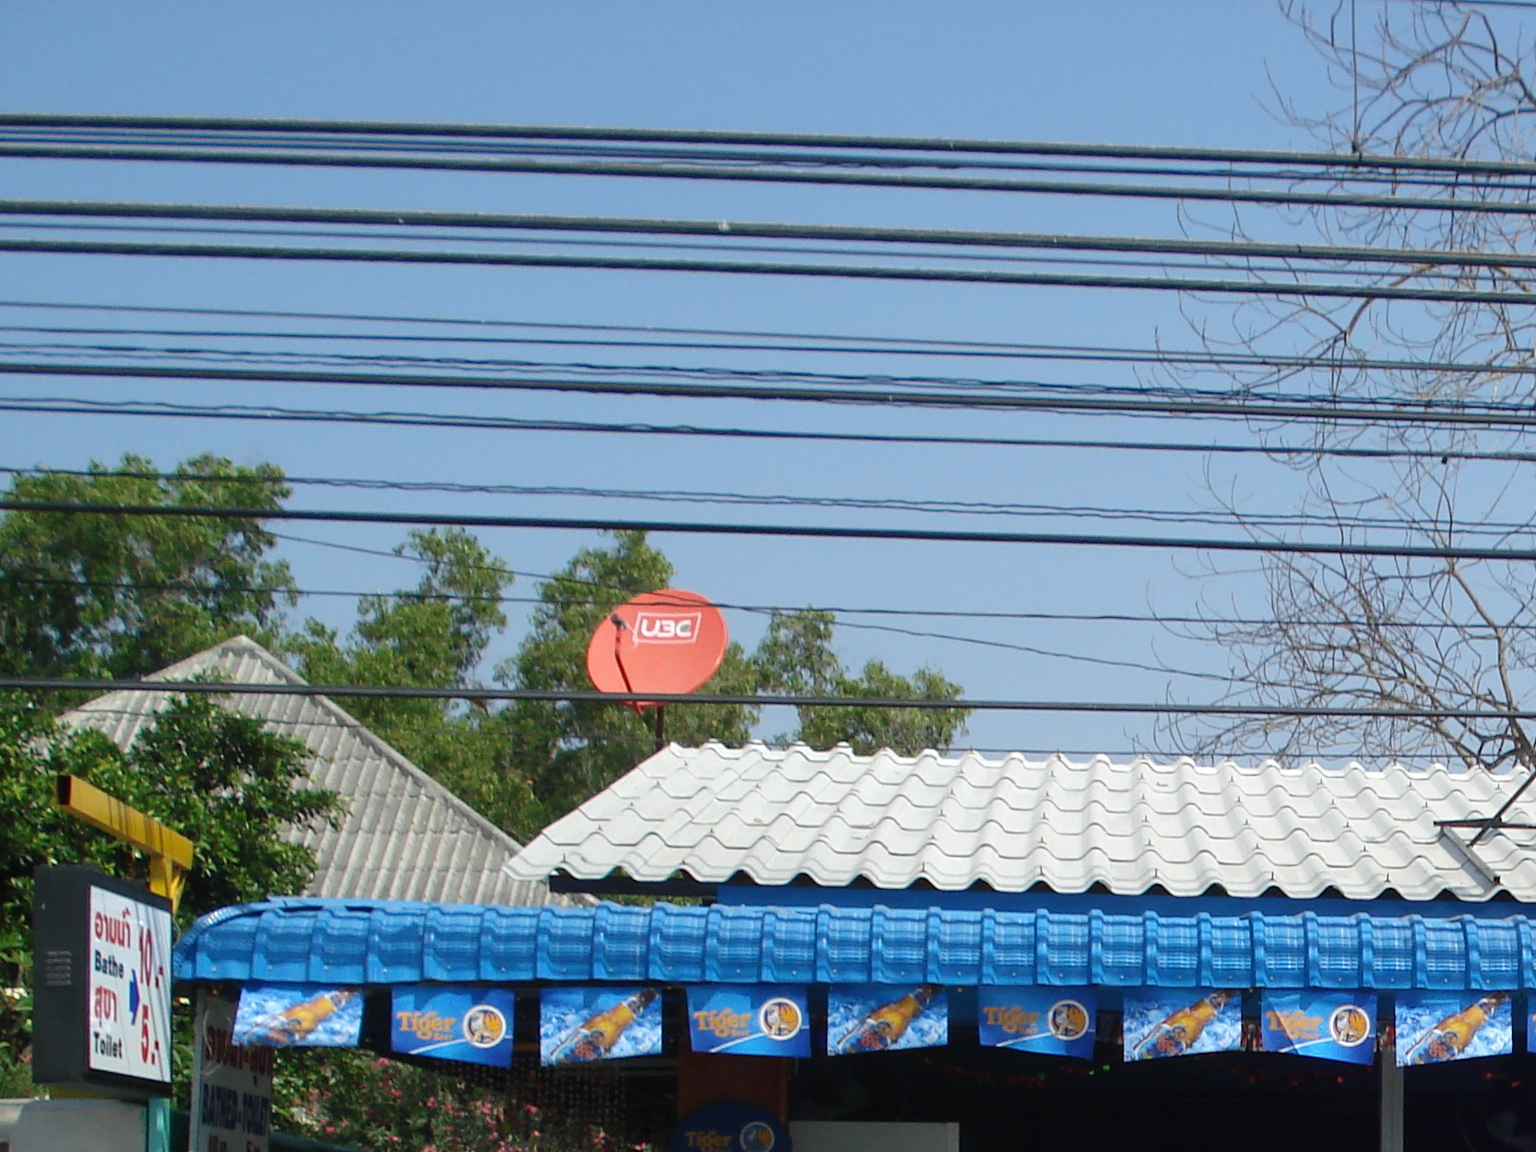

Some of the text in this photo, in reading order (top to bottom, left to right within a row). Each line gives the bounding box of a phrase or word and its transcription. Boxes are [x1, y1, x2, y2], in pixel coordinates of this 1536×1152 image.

[641, 618, 692, 638] UBC
[94, 907, 132, 949] อาบน้ำ
[94, 950, 125, 979] Bathe
[396, 1012, 456, 1039] Tiger
[694, 1010, 751, 1037] Tiger
[983, 1007, 1041, 1036] Tiger
[1266, 1012, 1322, 1040] Tiger
[93, 1032, 123, 1059] Toilet
